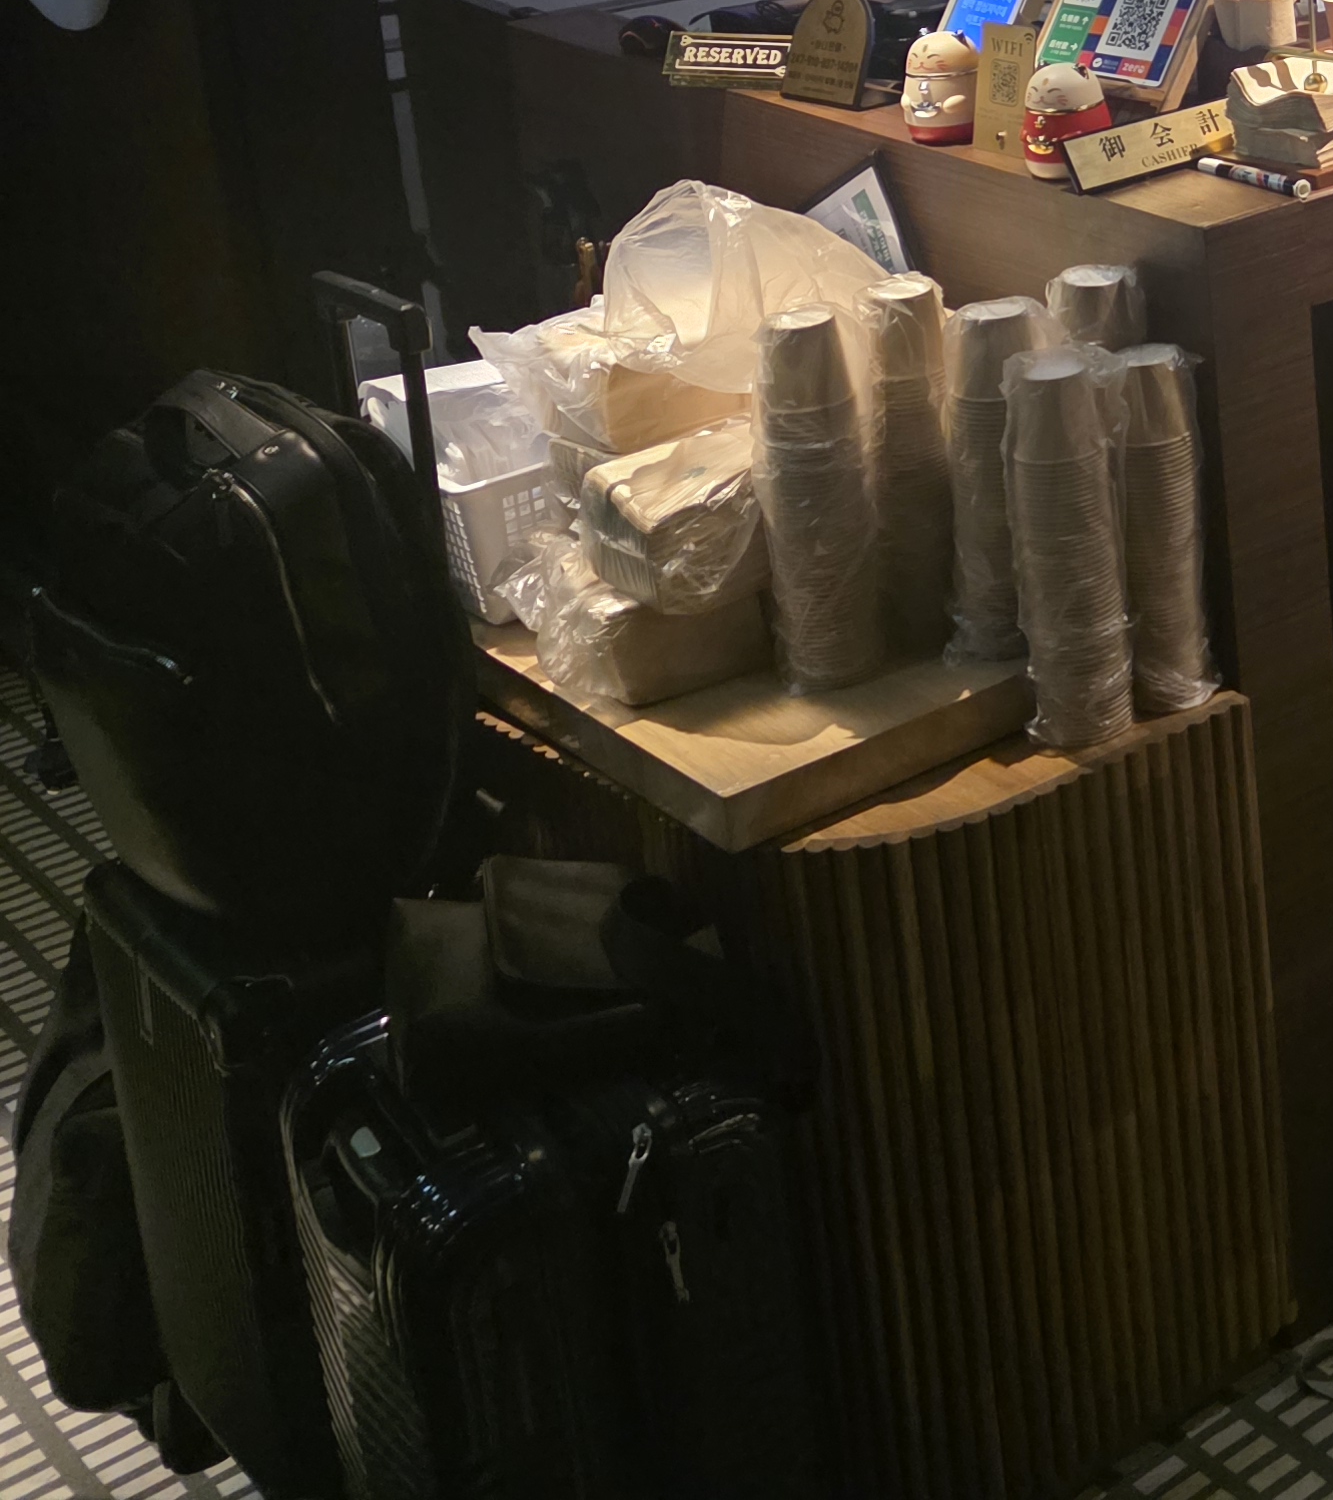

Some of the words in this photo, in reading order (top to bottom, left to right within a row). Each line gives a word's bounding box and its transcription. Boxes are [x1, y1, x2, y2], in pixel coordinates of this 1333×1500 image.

[683, 46, 782, 65] RESERVED
[991, 37, 1023, 57] WIFI
[1098, 108, 1220, 162] 御会計
